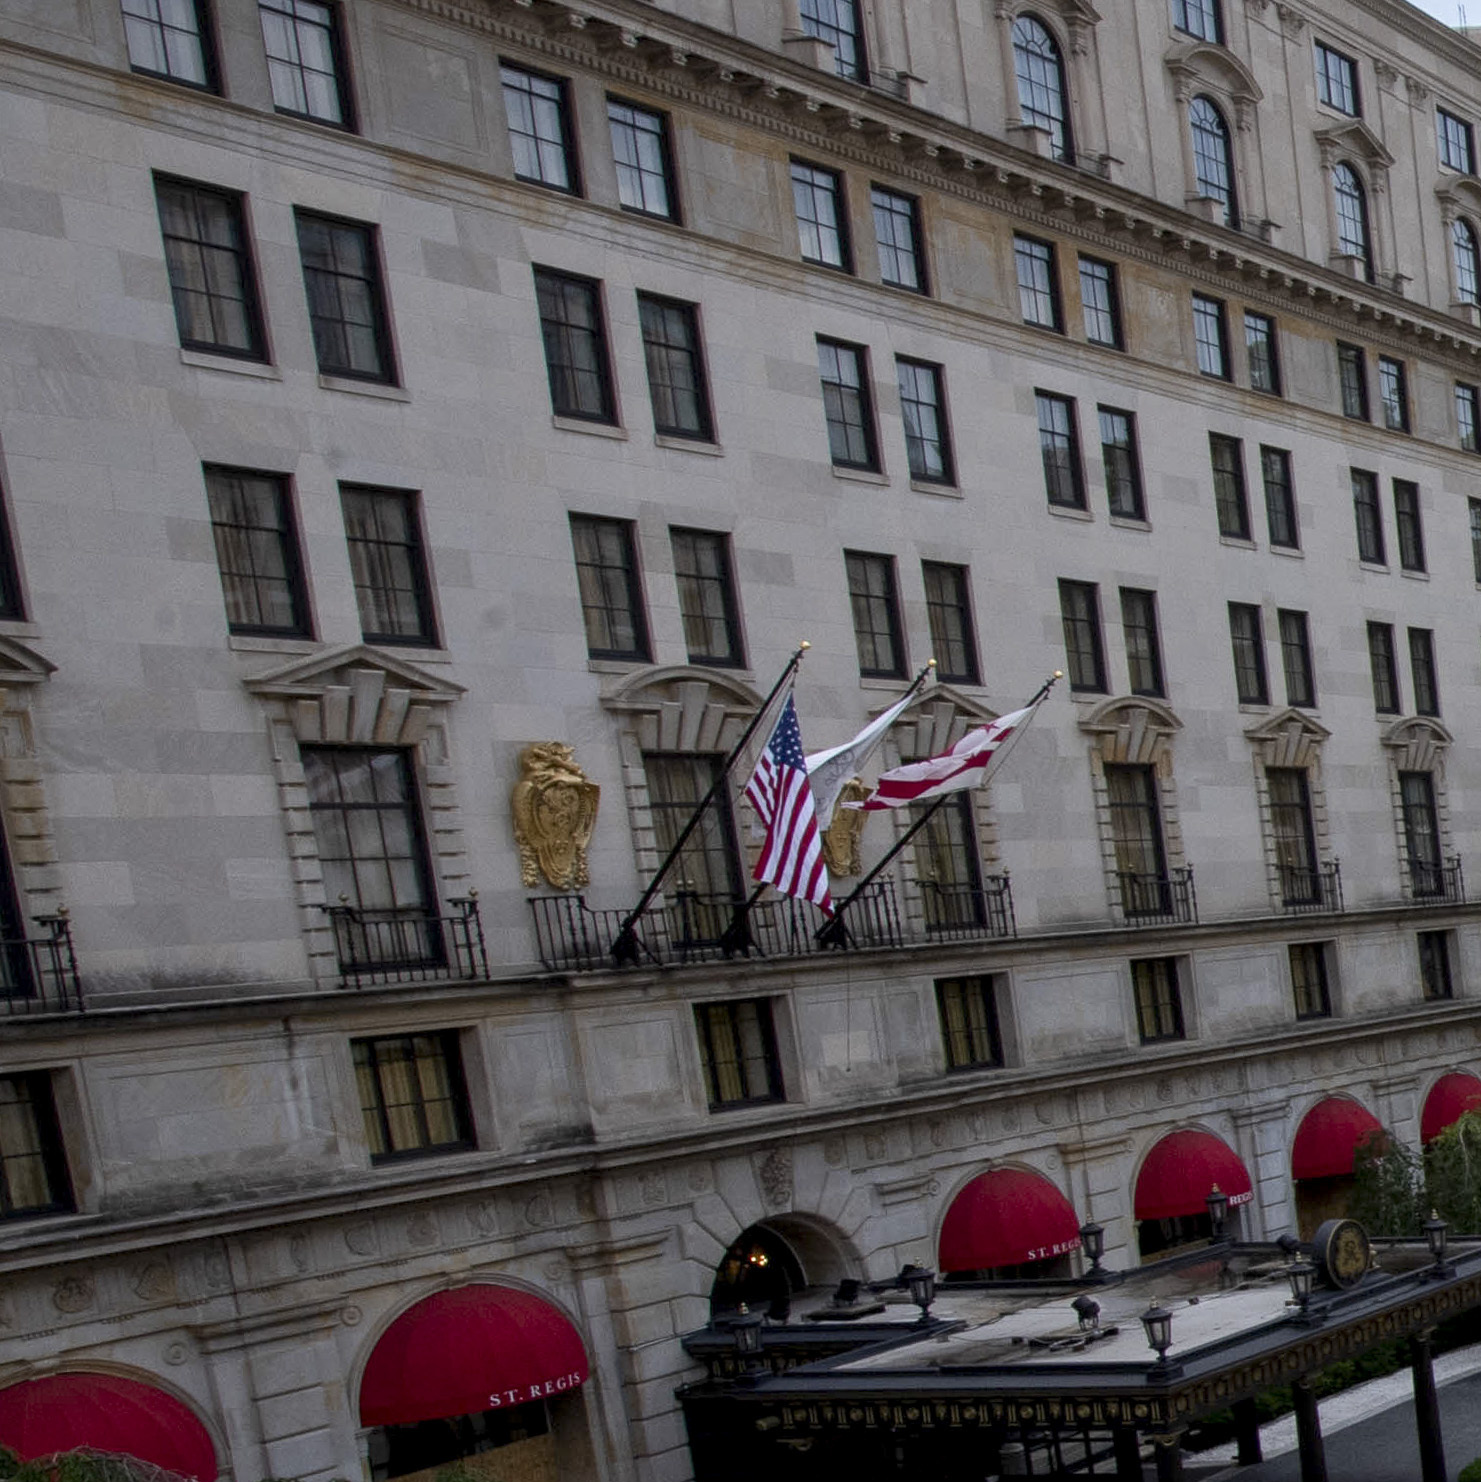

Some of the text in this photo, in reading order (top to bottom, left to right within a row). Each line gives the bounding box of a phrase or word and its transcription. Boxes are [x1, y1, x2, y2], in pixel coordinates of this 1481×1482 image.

[1028, 1246, 1050, 1260] ST.
[489, 1372, 581, 1407] ST. REGIS
